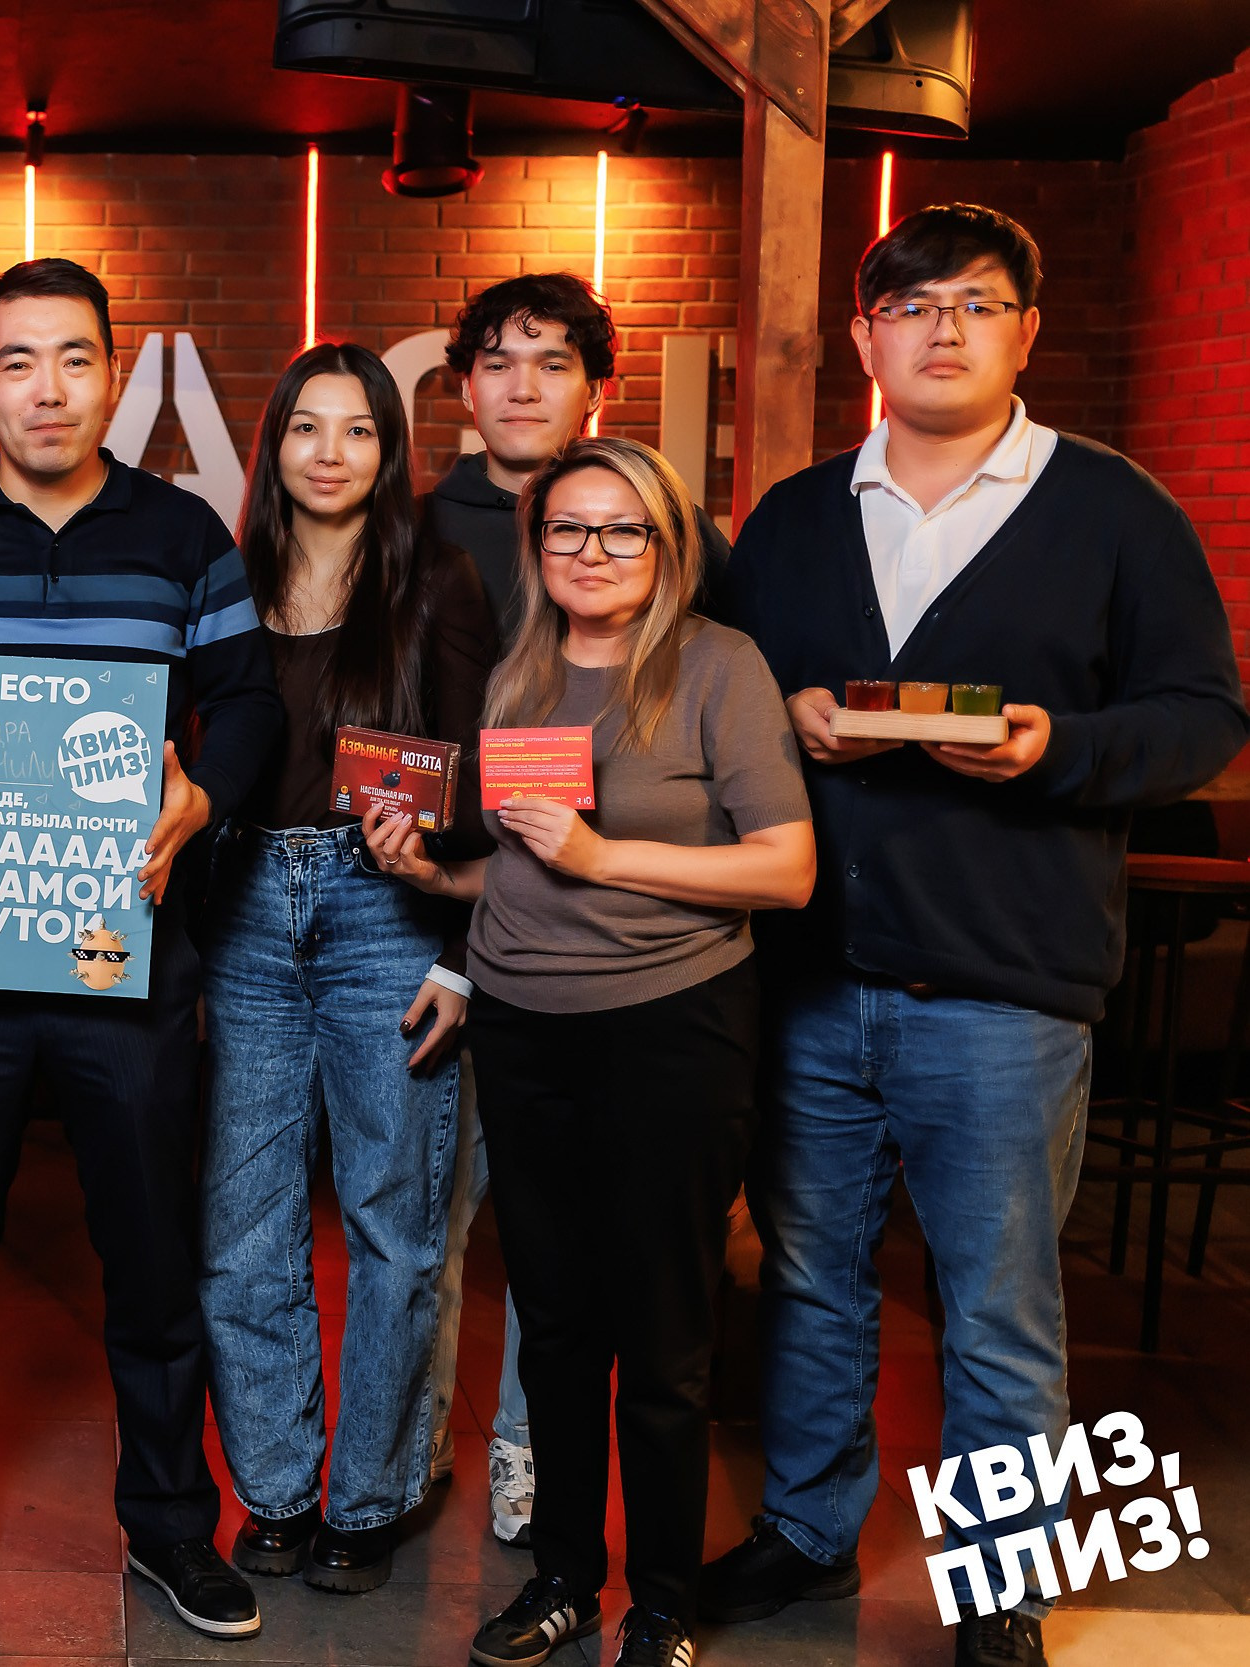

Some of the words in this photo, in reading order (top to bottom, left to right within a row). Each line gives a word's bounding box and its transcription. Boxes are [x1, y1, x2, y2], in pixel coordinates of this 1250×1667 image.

[60, 724, 149, 762] КВИЗ,
[339, 737, 399, 763] ВЗРЫВНЫЕ
[401, 750, 442, 771] КОТЯТА
[62, 749, 151, 788] ПЛИЗ!
[360, 784, 397, 800] НАСТОЛЬНАЯ
[398, 792, 413, 803] ИГРА
[20, 813, 73, 829] БЫЛА
[76, 816, 138, 833] ПОЧТИ
